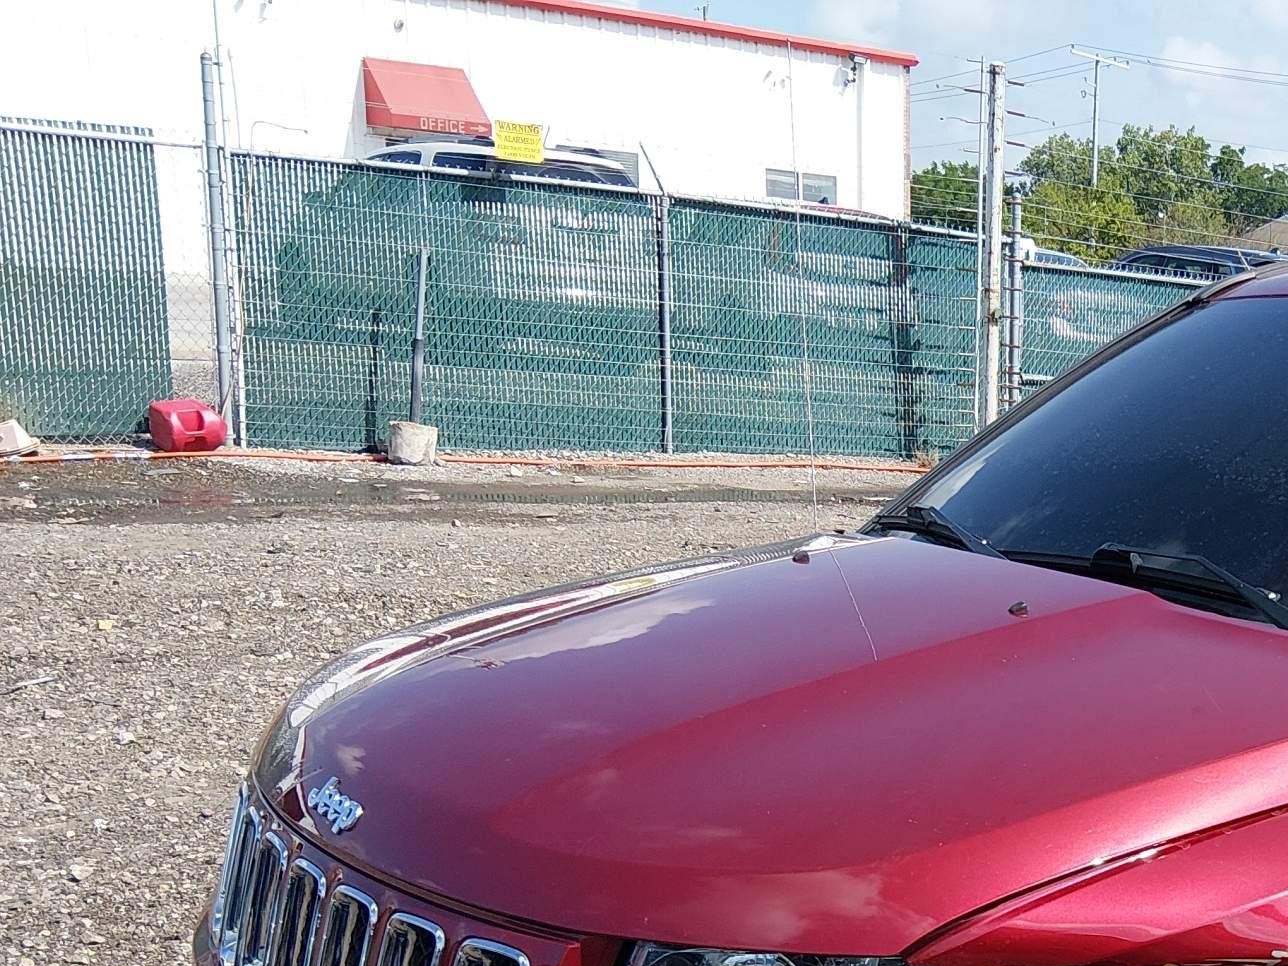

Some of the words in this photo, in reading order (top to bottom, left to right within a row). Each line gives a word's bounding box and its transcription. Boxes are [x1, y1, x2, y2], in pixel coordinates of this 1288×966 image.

[420, 117, 466, 134] OFFICE
[498, 121, 540, 135] WARNING
[307, 776, 364, 834] Jeep
